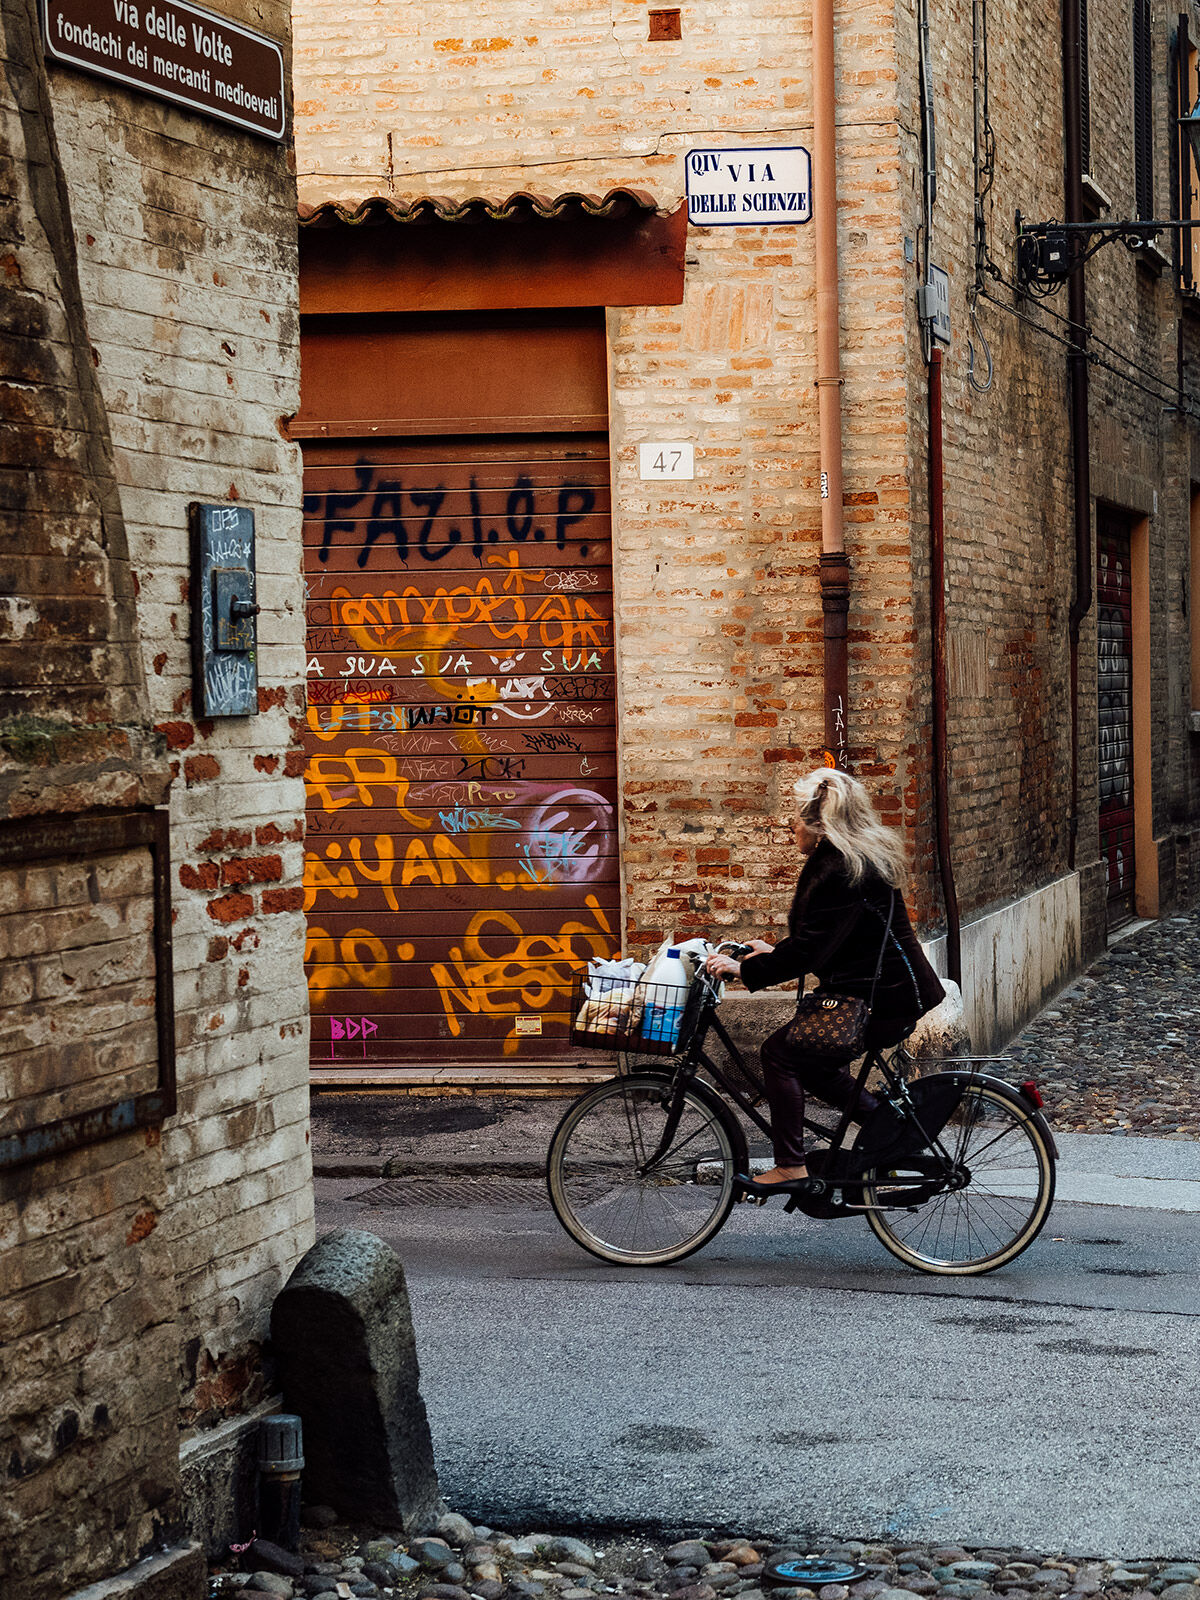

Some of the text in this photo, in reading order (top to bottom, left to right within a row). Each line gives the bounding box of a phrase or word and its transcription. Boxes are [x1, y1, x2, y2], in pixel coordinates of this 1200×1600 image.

[145, 6, 187, 48] delle
[191, 22, 233, 67] Volte
[57, 12, 278, 120] fondachi dei mercanti medioevali
[726, 163, 776, 182] VIA
[689, 192, 807, 214] DELLE SCIENZE
[652, 450, 682, 473] 47
